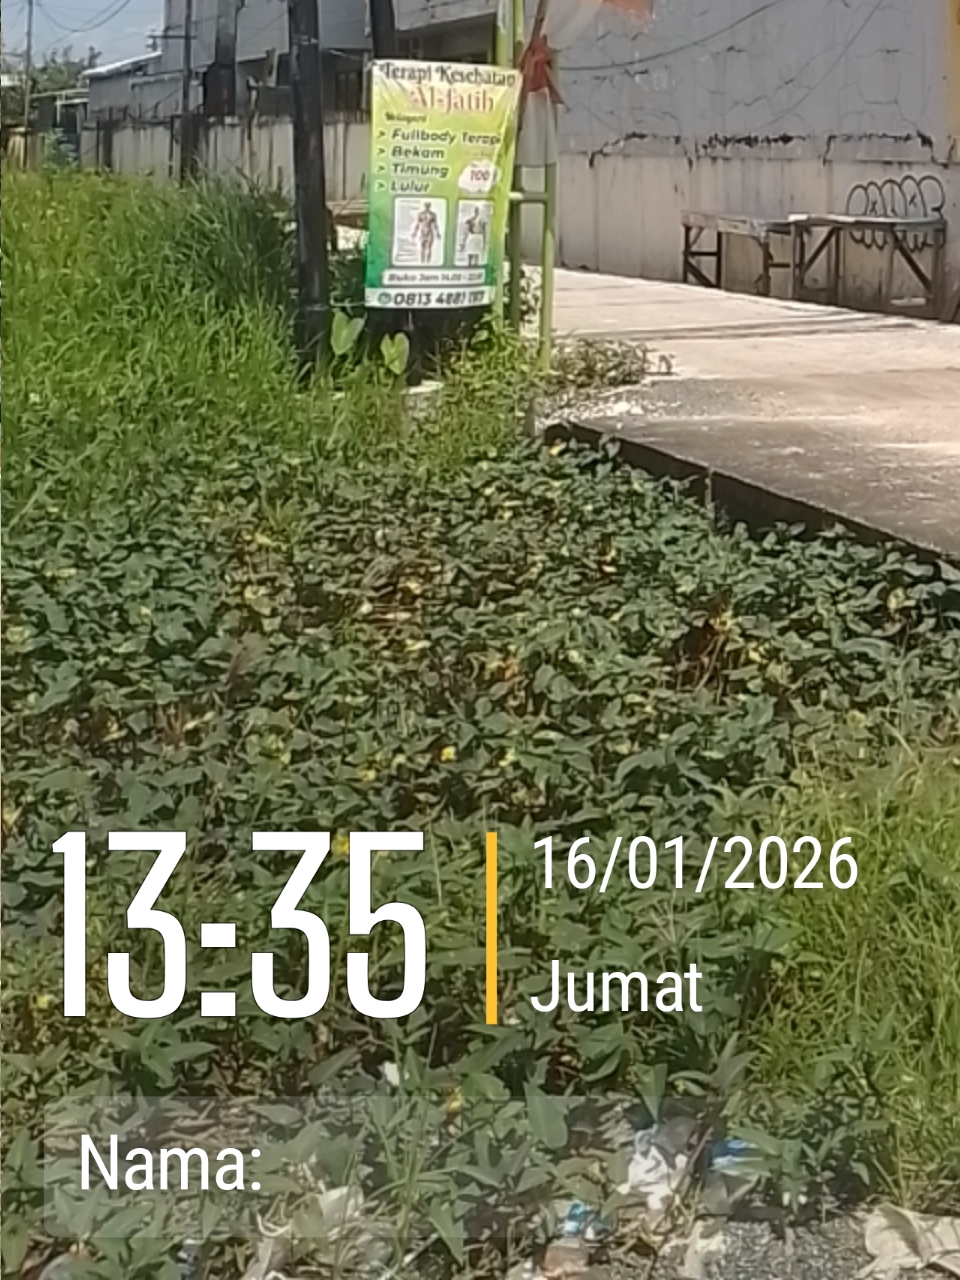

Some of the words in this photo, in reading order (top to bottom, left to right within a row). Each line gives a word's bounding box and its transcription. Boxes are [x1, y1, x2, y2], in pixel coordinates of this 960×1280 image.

[380, 62, 432, 84] Terapi
[391, 128, 456, 143] Fullbody
[463, 131, 500, 146] Terapi
[391, 146, 445, 158] Bekam
[392, 163, 449, 178] Timung
[391, 181, 429, 192] Lulur
[393, 291, 432, 306] 0813
